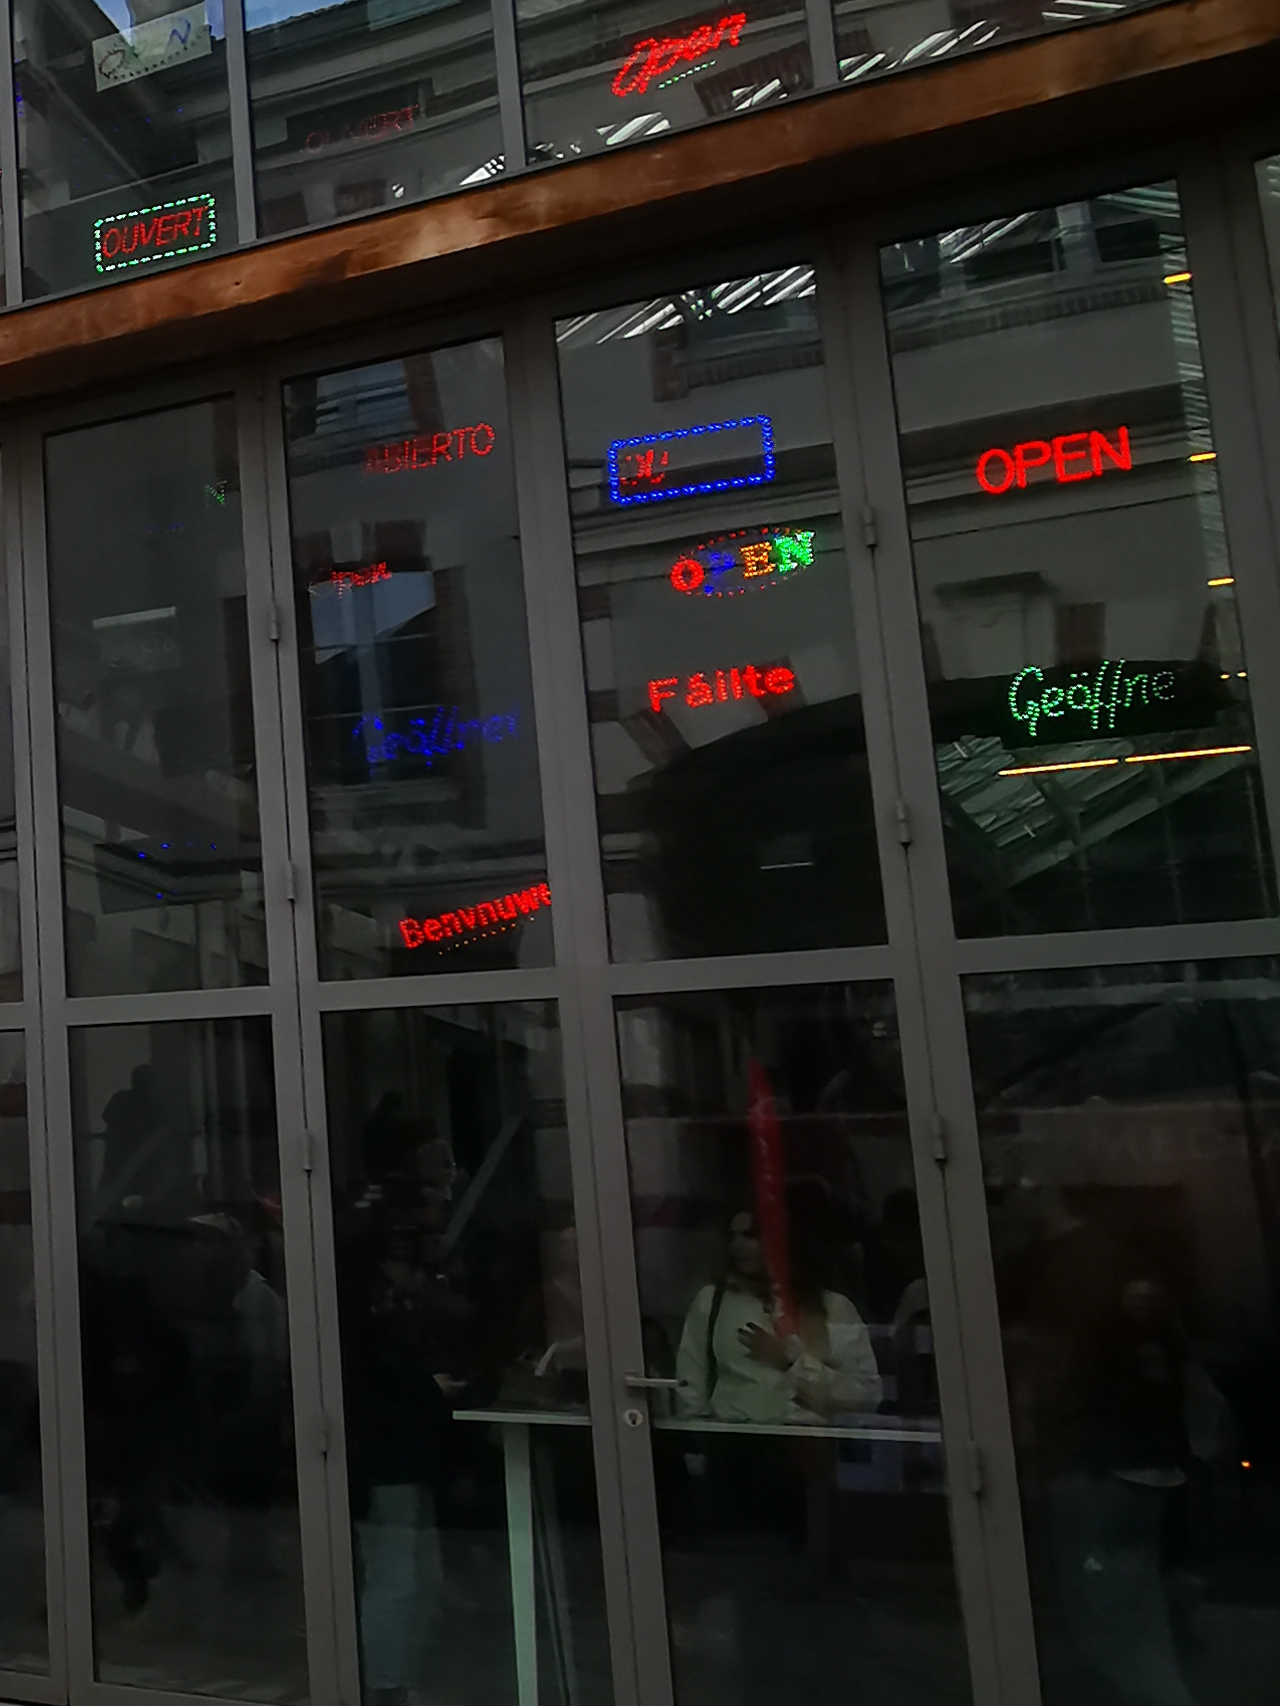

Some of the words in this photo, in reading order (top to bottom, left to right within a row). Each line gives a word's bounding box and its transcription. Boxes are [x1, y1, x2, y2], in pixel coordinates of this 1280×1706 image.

[611, 12, 747, 97] Open
[101, 204, 209, 259] OUVERT
[976, 425, 1133, 495] OPEN
